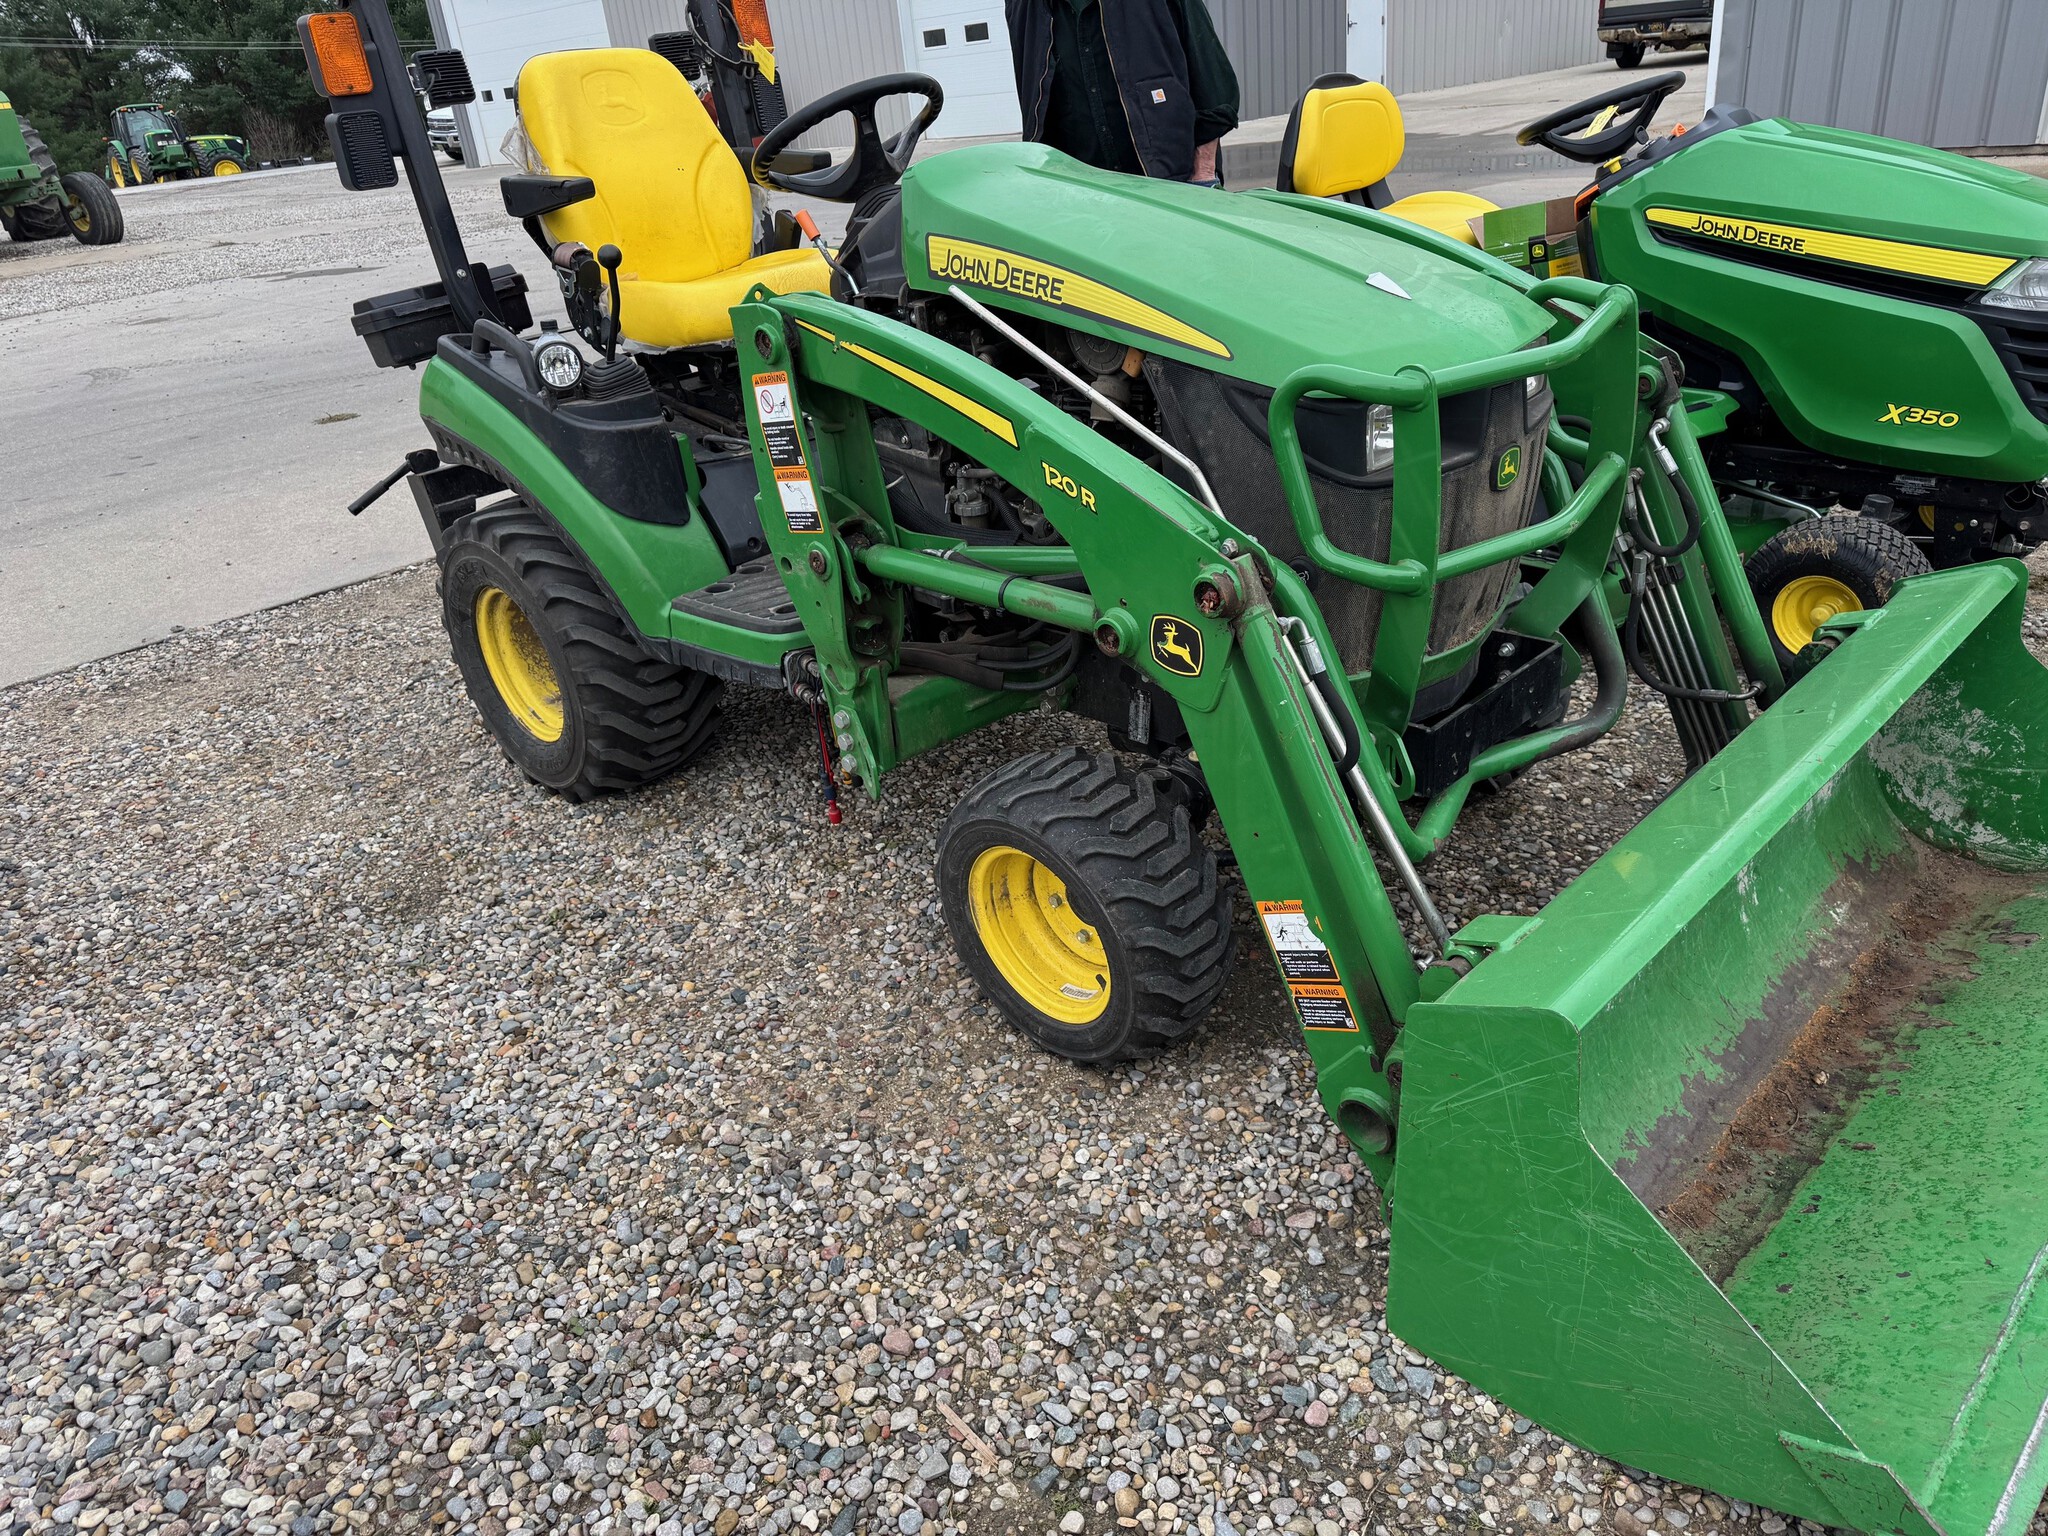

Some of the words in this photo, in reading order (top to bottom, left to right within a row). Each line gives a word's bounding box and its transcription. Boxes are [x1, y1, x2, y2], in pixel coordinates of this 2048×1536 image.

[1691, 215, 1740, 240] JOHN
[1742, 225, 1806, 253] DEERE
[939, 248, 990, 282] JOHN
[993, 258, 1065, 301] DEERE
[759, 374, 786, 383] WARNING
[1876, 402, 1960, 427] X350
[781, 471, 808, 480] WARNING
[1271, 903, 1303, 911] WARNIN
[1303, 988, 1340, 996] WARNING
